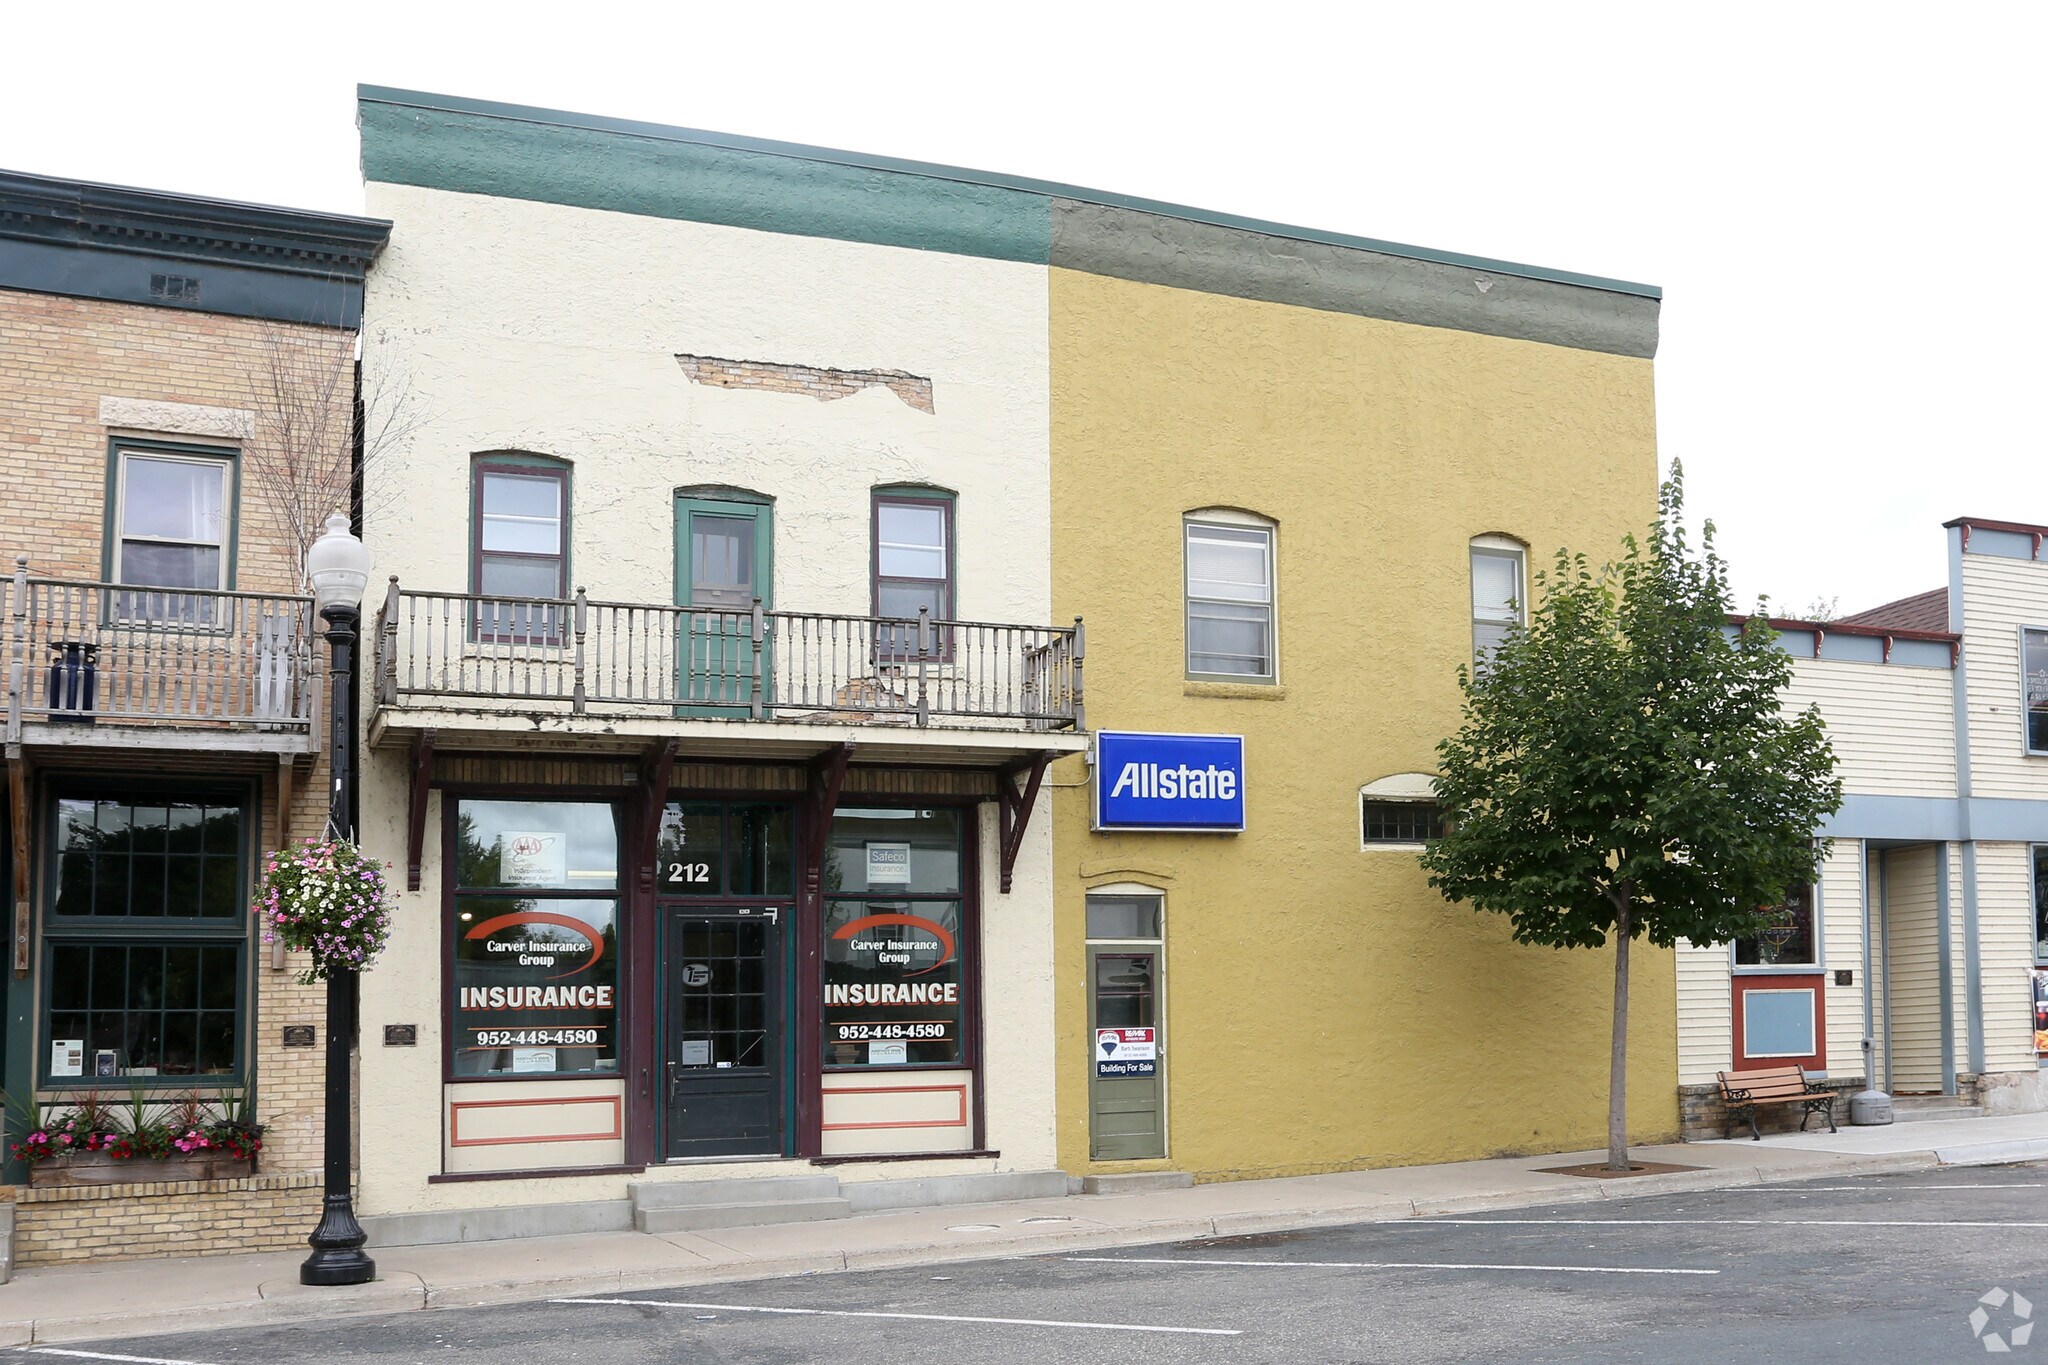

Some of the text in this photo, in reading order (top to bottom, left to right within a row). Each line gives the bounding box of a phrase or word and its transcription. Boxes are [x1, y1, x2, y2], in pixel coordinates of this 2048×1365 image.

[1110, 762, 1236, 800] Allstate
[515, 837, 540, 853] AAA
[872, 851, 905, 862] Safeco
[668, 863, 710, 882] 212
[870, 865, 904, 873] Insurance
[487, 940, 586, 952] Carver Insurance
[850, 939, 938, 950] Carver Insurance
[519, 954, 555, 967] Group
[878, 952, 910, 964] Group
[460, 985, 613, 1010] INSURANCE
[824, 983, 958, 1006] INSURANCE
[477, 1029, 598, 1045] 952-448-4580
[839, 1024, 945, 1039] 952-448-4580
[1101, 1063, 1153, 1073] Building For Sale
